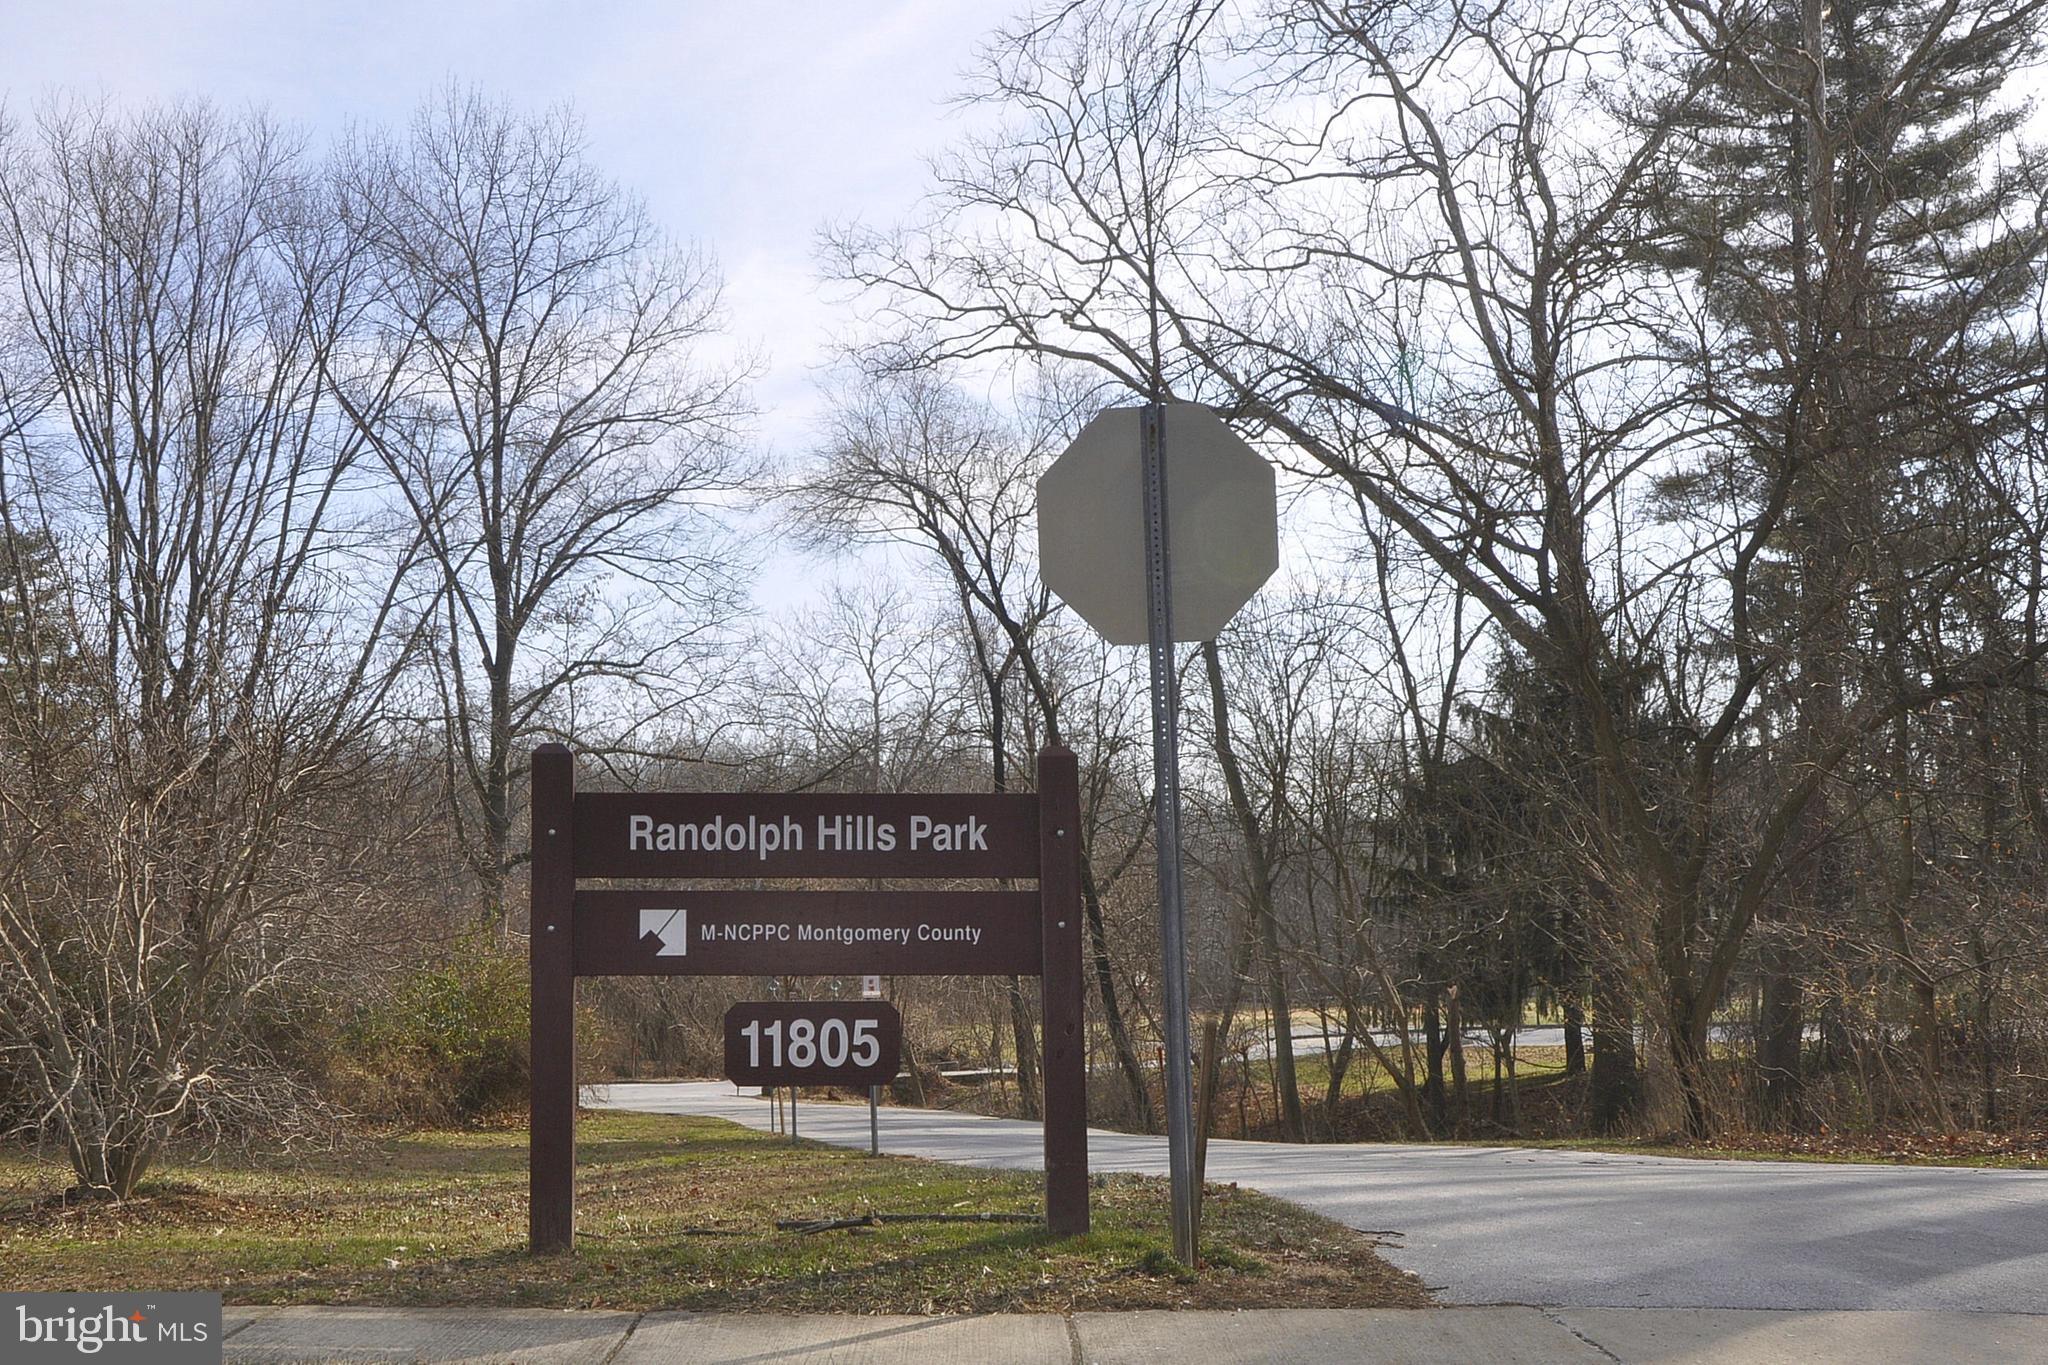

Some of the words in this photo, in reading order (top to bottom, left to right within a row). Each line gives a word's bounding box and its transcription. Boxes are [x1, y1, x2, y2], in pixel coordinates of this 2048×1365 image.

[629, 815, 803, 860] Randolph
[817, 815, 896, 851] Hills
[910, 815, 988, 851] Park
[701, 923, 791, 941] M-NCPPC
[797, 923, 911, 946] Montgomery
[917, 923, 982, 946] County
[740, 1018, 881, 1068] 11805
